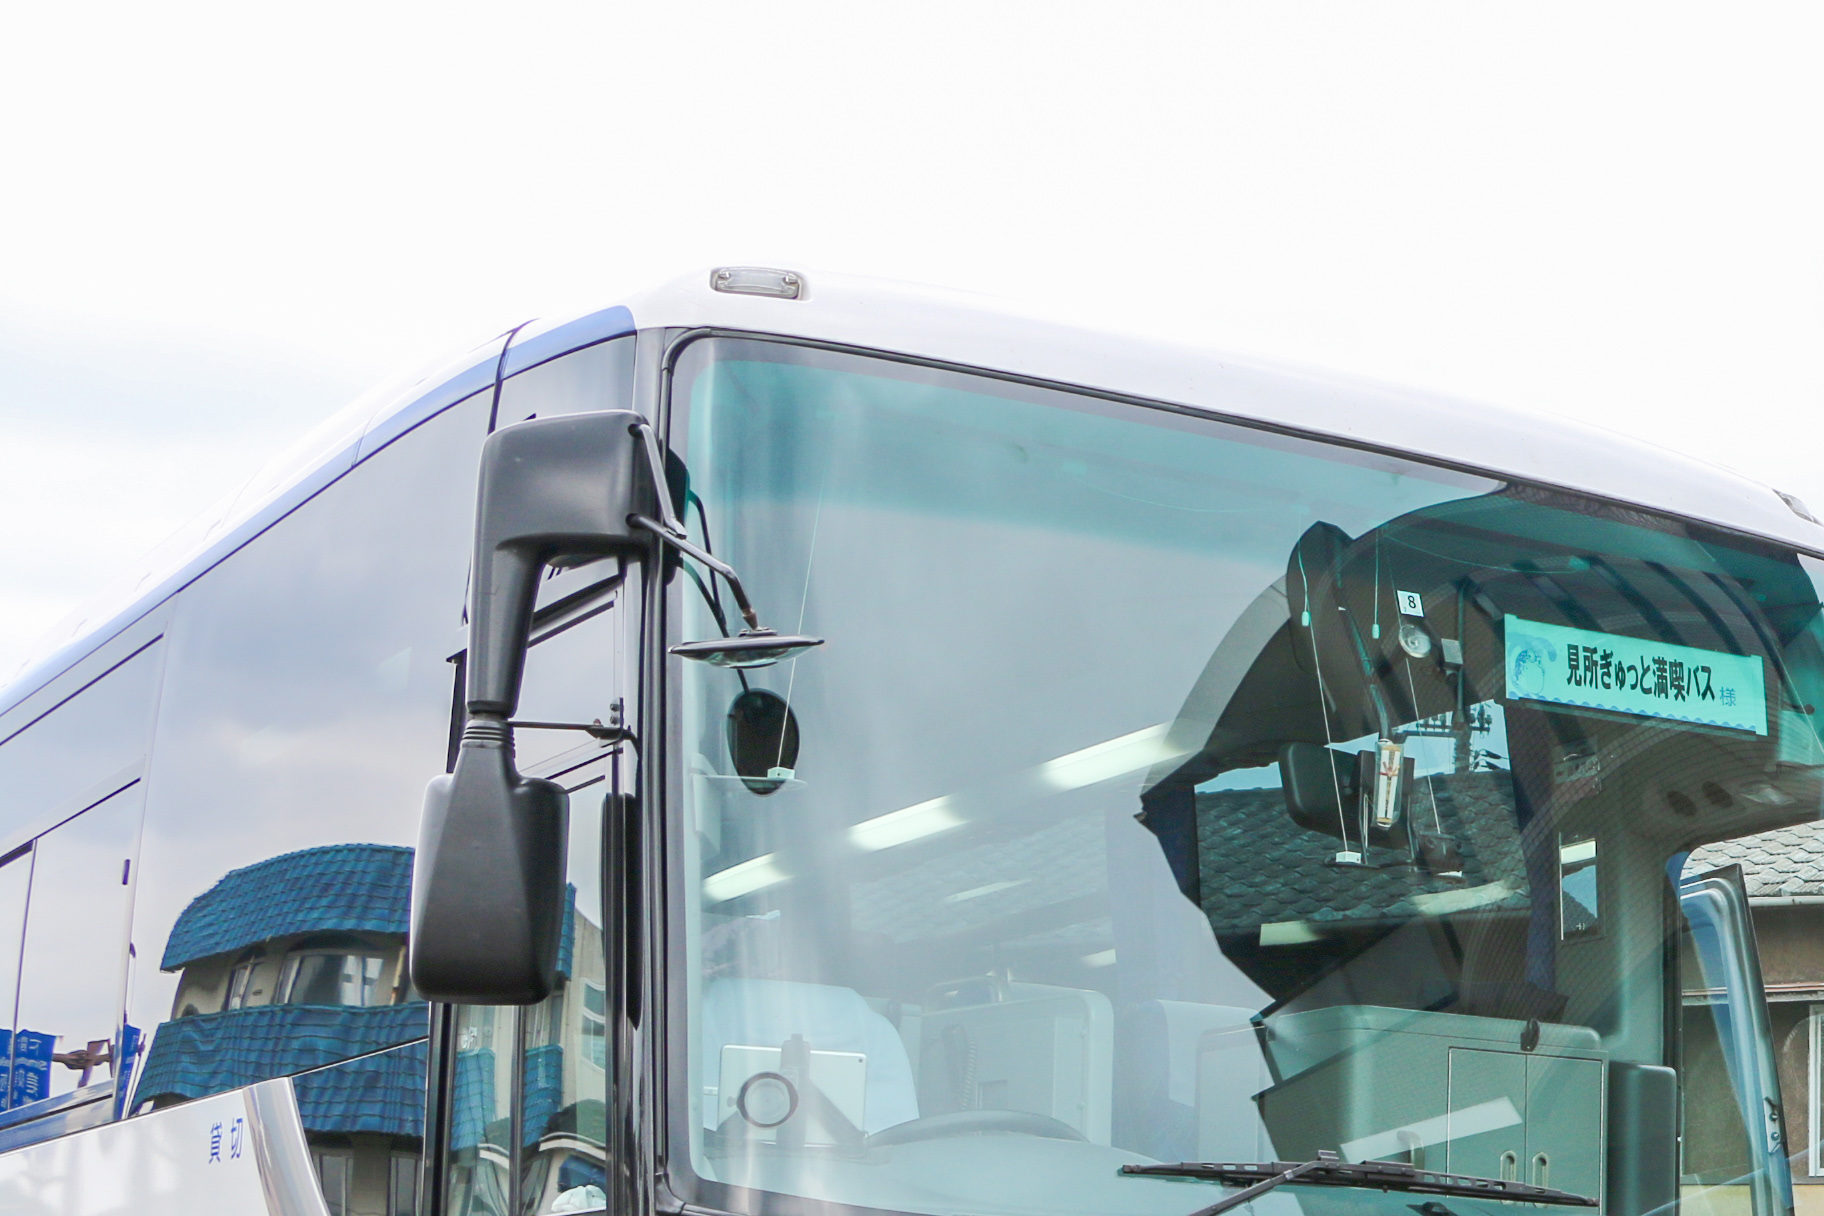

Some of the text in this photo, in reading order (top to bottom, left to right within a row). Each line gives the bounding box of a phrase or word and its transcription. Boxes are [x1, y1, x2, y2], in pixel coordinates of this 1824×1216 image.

[1407, 595, 1417, 609] 8
[1566, 643, 1715, 702] 見所ぎゅっと満喫バス
[209, 1117, 244, 1164] 貸切
